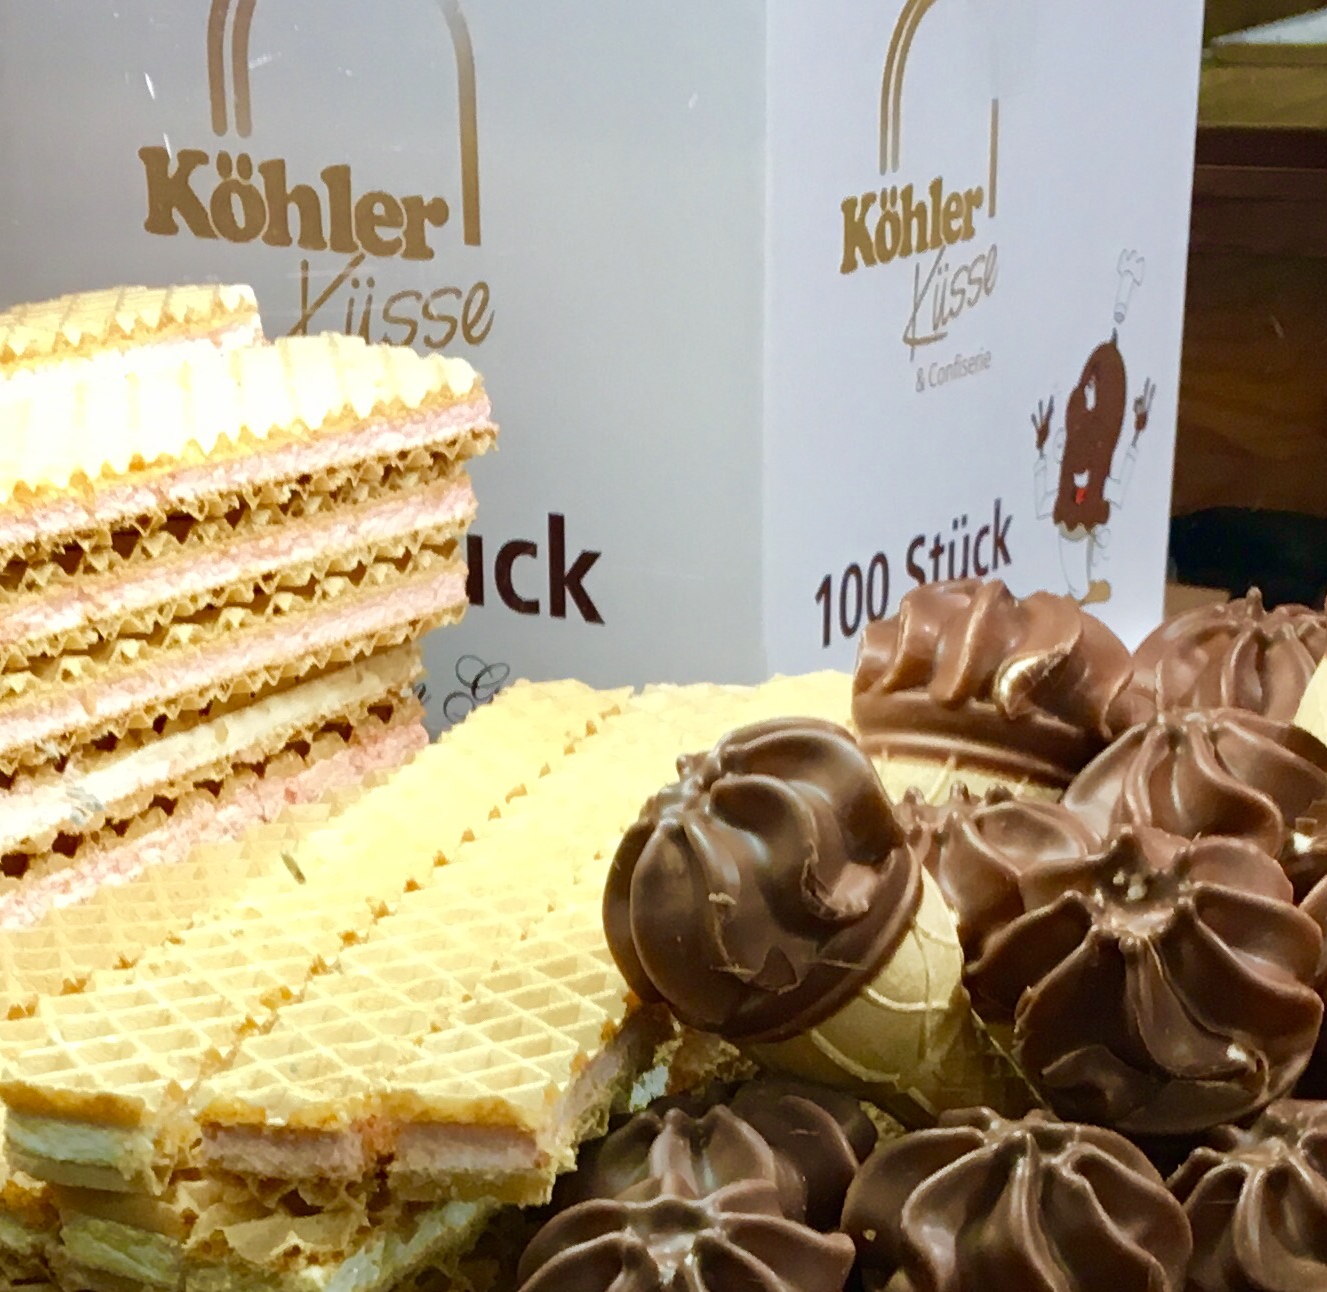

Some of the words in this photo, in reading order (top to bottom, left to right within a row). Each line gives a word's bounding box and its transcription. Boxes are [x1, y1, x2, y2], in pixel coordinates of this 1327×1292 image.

[138, 146, 449, 261] Köhler
[840, 176, 984, 274] Köhler
[286, 252, 496, 348] Küsse
[902, 244, 998, 363] Küsse
[915, 367, 925, 393] &
[815, 550, 890, 647] 100
[905, 497, 1014, 586] Stück
